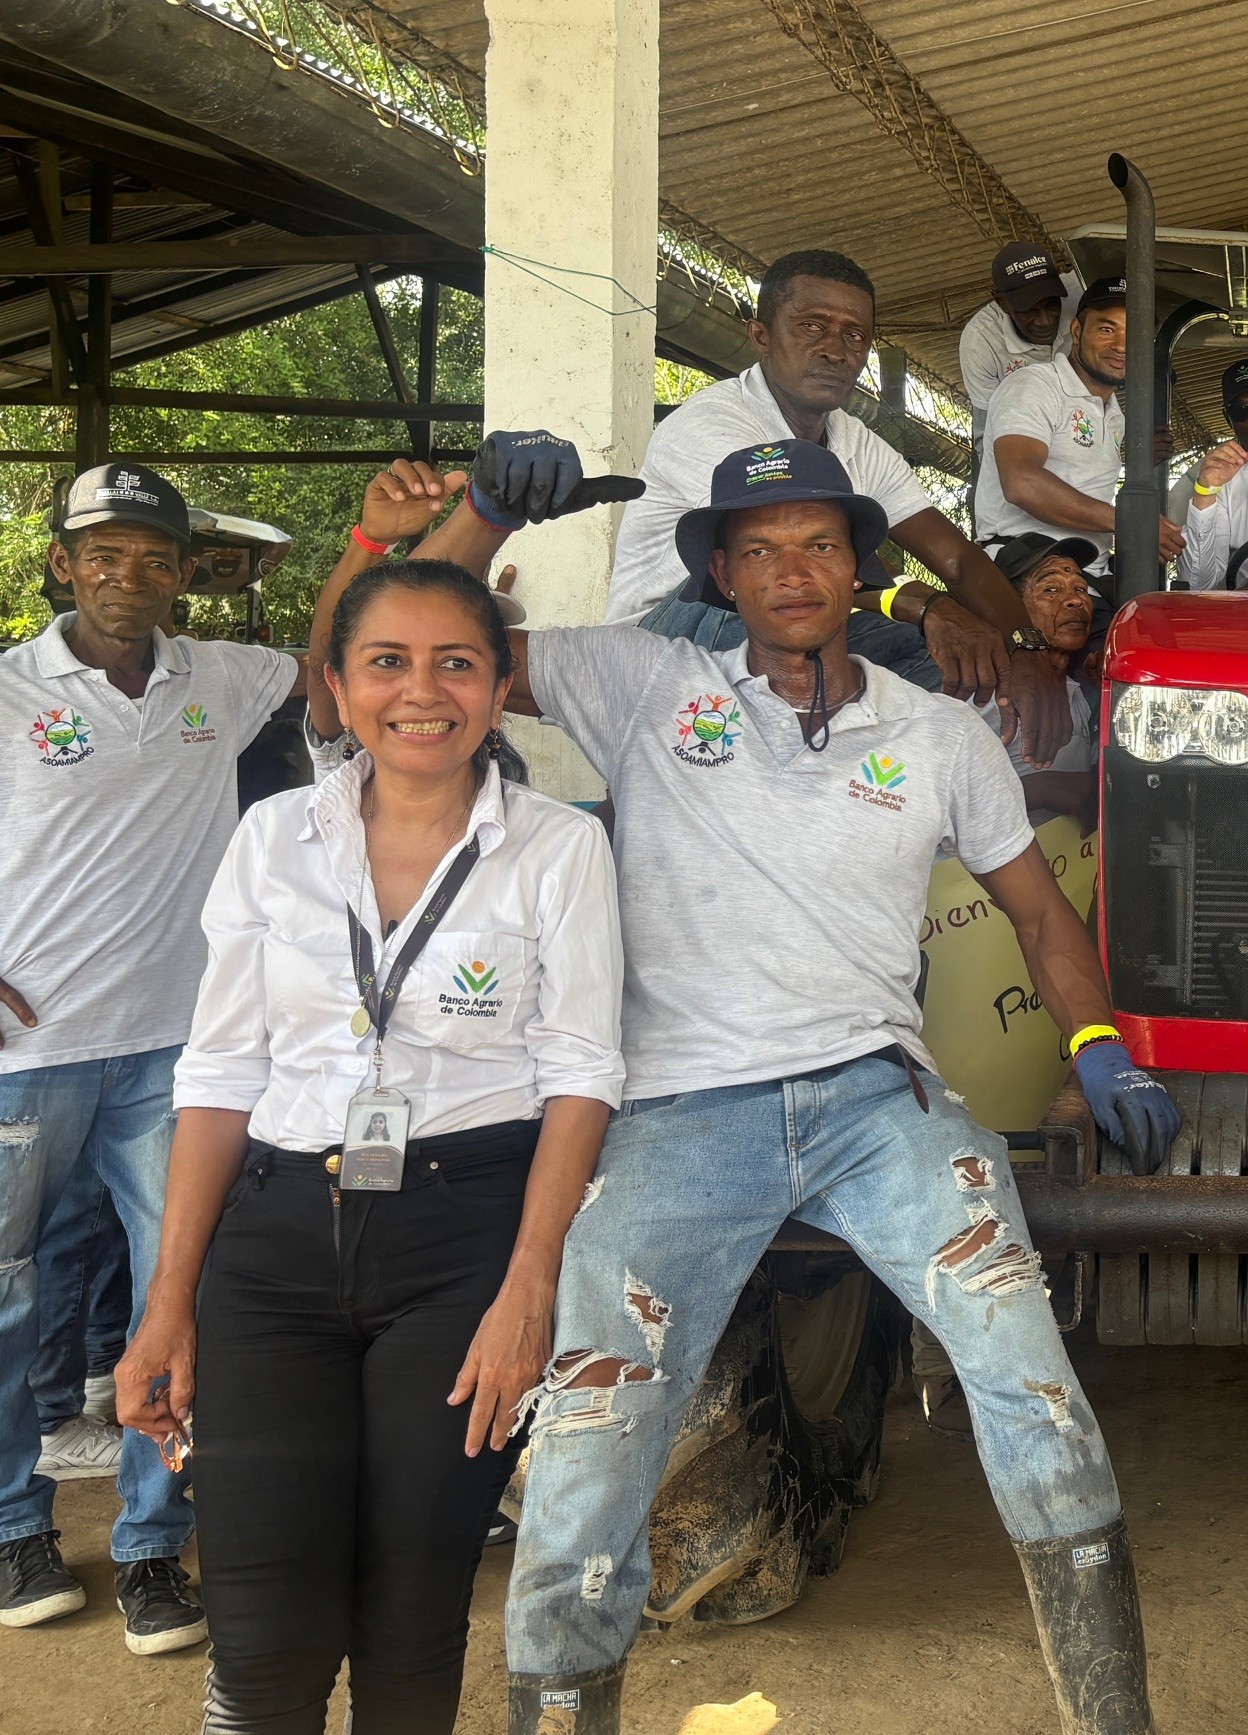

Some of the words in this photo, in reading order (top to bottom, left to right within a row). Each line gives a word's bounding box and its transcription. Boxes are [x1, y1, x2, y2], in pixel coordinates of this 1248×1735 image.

[1012, 256, 1047, 271] Fenalce
[766, 458, 791, 466] Agrario
[39, 747, 95, 768] ASOAMIAMPRO
[671, 744, 735, 768] ASOAMIAMPRO
[848, 779, 875, 795] Banco
[876, 788, 907, 804] Agrario
[848, 789, 860, 799] de
[863, 793, 903, 812] Colombia
[438, 993, 470, 1006] Banco
[473, 998, 503, 1010] Agrario
[440, 1002, 454, 1014] de
[456, 1006, 498, 1018] Colombia
[543, 1694, 551, 1703] LA
[552, 1691, 577, 1703] MACHA
